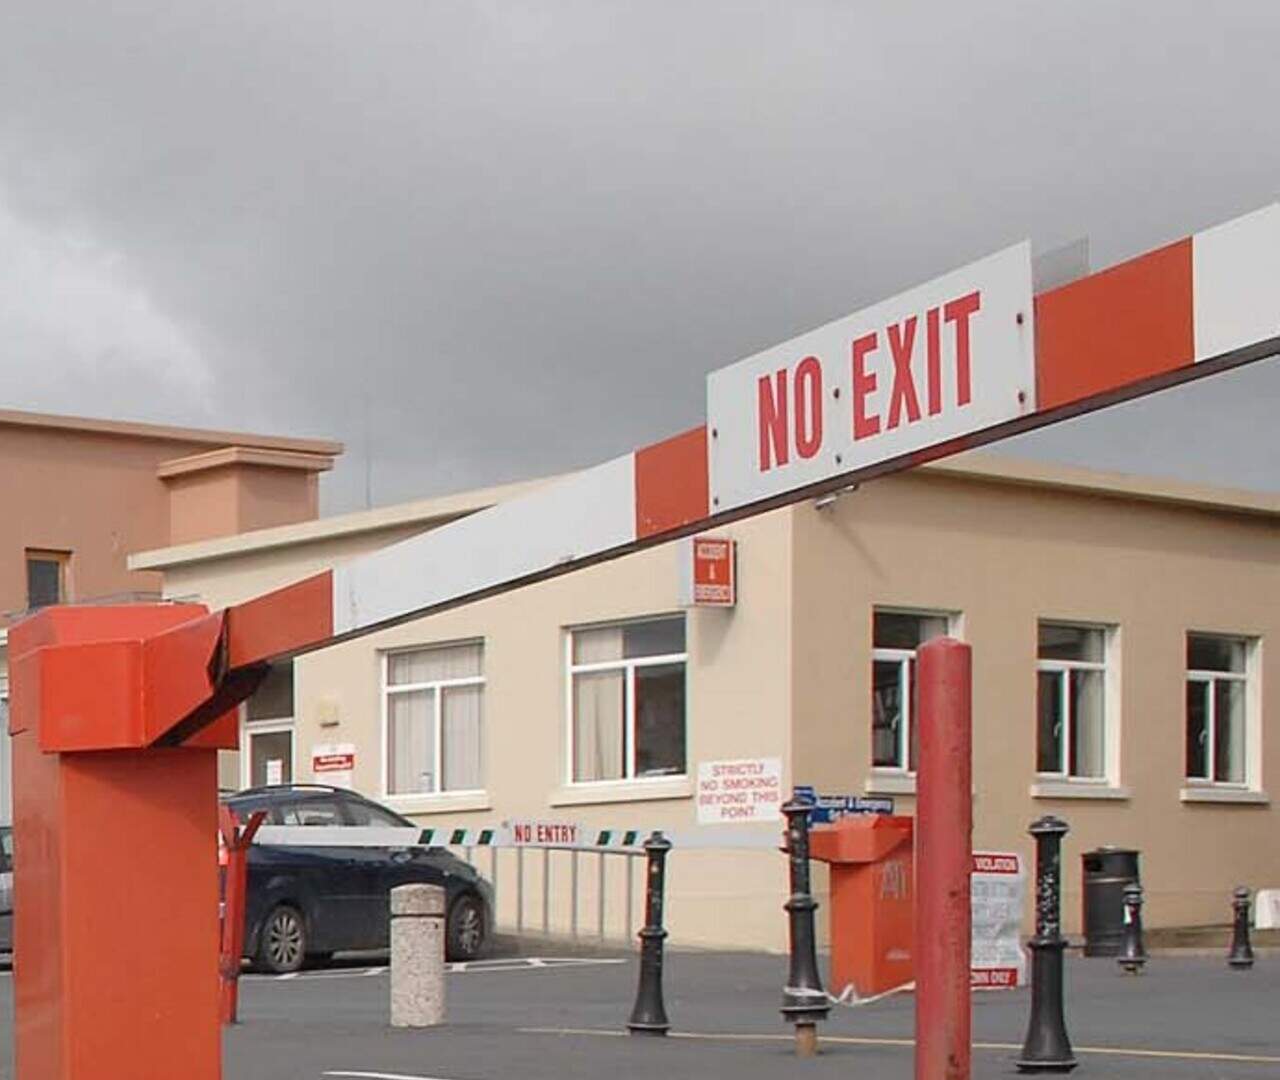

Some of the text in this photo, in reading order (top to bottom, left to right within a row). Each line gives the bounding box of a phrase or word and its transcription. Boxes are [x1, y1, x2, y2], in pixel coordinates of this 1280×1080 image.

[758, 291, 981, 473] NO EXIT
[712, 763, 764, 777] STRICTLY
[701, 776, 778, 791] NO SMOKING
[700, 791, 779, 806] BEYOND THIS
[721, 805, 755, 818] POINT
[514, 825, 576, 842] NO ENTRY
